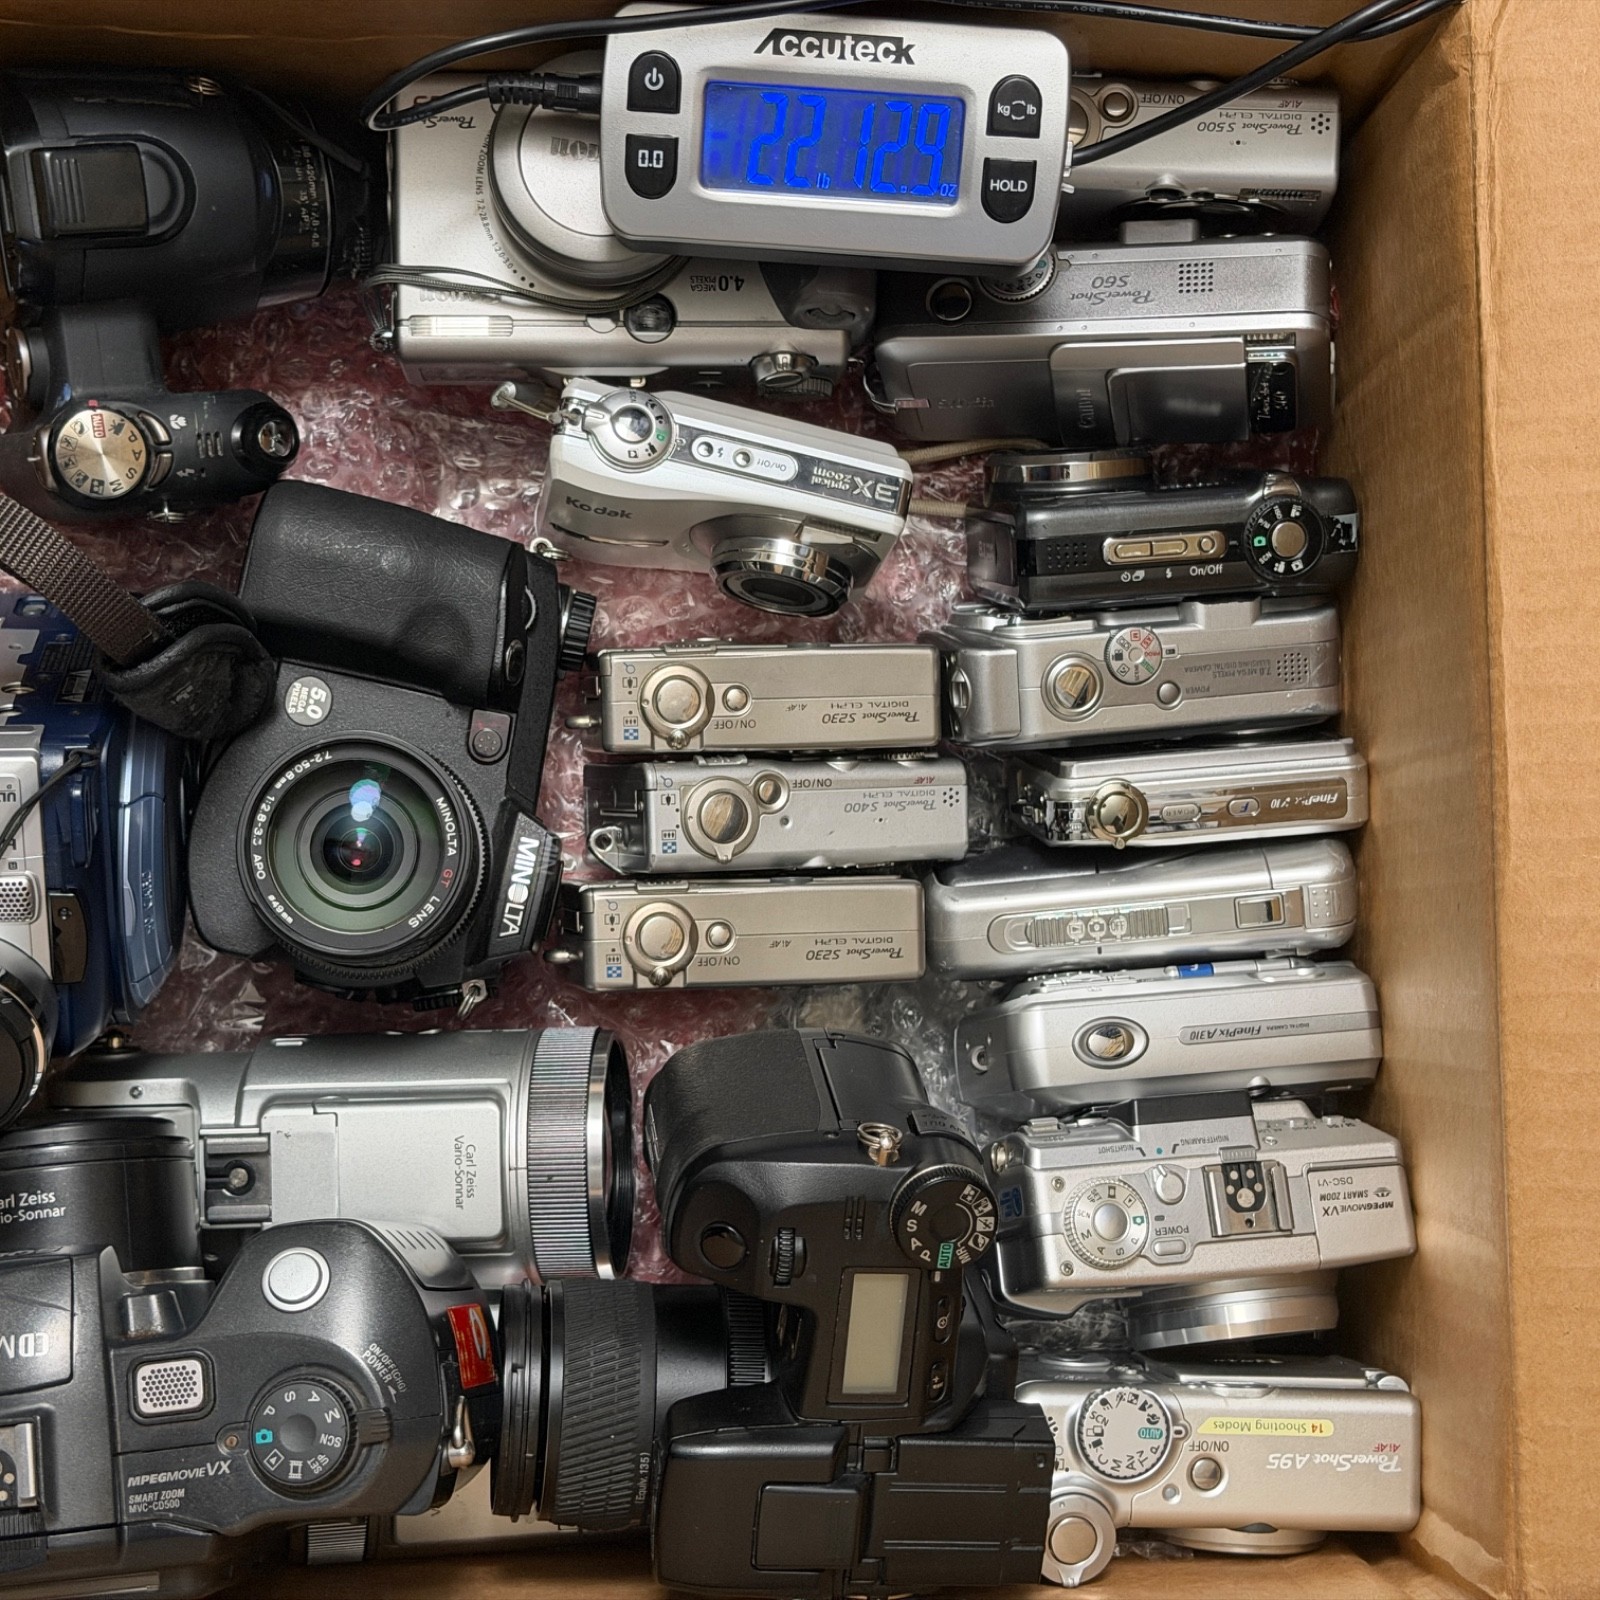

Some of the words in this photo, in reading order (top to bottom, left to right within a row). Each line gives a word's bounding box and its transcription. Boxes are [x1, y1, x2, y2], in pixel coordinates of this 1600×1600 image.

[754, 27, 917, 65] Accuteck
[1140, 92, 1186, 106] ON/OFF
[997, 101, 1011, 118] kg
[1026, 103, 1037, 115] lb
[1258, 112, 1303, 121] DIGITAL
[1197, 120, 1237, 133] S500
[1242, 121, 1303, 136] PowerShot
[745, 92, 828, 189] 22
[816, 172, 832, 190] lb
[852, 101, 952, 197] 12.9
[476, 148, 488, 173] ZOOM
[475, 173, 485, 196] LENS
[989, 176, 1029, 193] HOLD
[689, 274, 717, 283] PIXELS
[718, 275, 745, 292] 4.0
[1091, 274, 1131, 289] S60
[690, 282, 716, 292] MEGA
[1070, 290, 1156, 306] PowerShot
[92, 412, 106, 439] AUTO
[124, 432, 136, 444] P
[131, 448, 142, 461] A
[756, 457, 788, 473] On/Off
[125, 466, 137, 480] S
[812, 464, 852, 482] zoom
[108, 478, 124, 494] M
[811, 474, 851, 493] optical
[853, 476, 900, 505] 3X
[565, 495, 635, 521] Kodak
[1258, 550, 1273, 565] SCN
[1189, 563, 1224, 577] On/Off
[287, 682, 302, 714] PIXELS
[1185, 686, 1211, 695] POWER
[295, 686, 309, 714] MEGA
[308, 686, 328, 720] 5.0
[871, 700, 910, 708] DIGITAL
[713, 718, 757, 730] ON/OFF
[821, 711, 857, 725] S230
[861, 709, 920, 725] PowerShot
[273, 750, 334, 791] 7.2-50.8mm
[791, 777, 833, 788] ON/OFF
[900, 788, 936, 797] DIGITAL
[843, 801, 878, 814] S400
[882, 798, 938, 812] PowerShot
[1165, 808, 1196, 817] POWER
[435, 796, 457, 858] MINOLTA
[252, 853, 267, 880] APO
[442, 867, 455, 889] GT
[499, 836, 540, 939] MINOLTA
[408, 895, 441, 929] LENS
[856, 935, 894, 944] DIGITAL
[805, 948, 841, 961] S230
[844, 945, 905, 960] PowerShot
[697, 955, 741, 967] ON/OFF
[1218, 1025, 1262, 1038] FinePix
[1289, 1022, 1310, 1030] DIGITAL
[1189, 1027, 1219, 1041] A310
[1180, 1134, 1230, 1147] NIGHTFRAMING
[465, 1143, 477, 1170] Carl
[1097, 1143, 1135, 1155] NIGHTSHOT
[452, 1134, 467, 1212] Vario-Sonnar
[463, 1171, 477, 1200] Zeiss
[1316, 1176, 1354, 1188] DSC-V1
[18, 1189, 57, 1208] Zeiss
[1086, 1193, 1097, 1204] UP
[1090, 1187, 1103, 1202] SET
[1318, 1191, 1342, 1202] ZOOM
[1342, 1188, 1370, 1200] SMART
[910, 1200, 928, 1217] M
[1076, 1208, 1091, 1219] SCN
[906, 1218, 919, 1233] S
[1154, 1224, 1190, 1237] POWER
[1080, 1228, 1093, 1242] M
[1130, 1236, 1140, 1247] P
[910, 1237, 923, 1252] A
[1096, 1245, 1106, 1257] A
[1115, 1246, 1126, 1257] S
[919, 1249, 932, 1263] P
[939, 1244, 952, 1269] AUTO
[362, 1348, 394, 1385] POWER
[367, 1342, 409, 1394] ON/OFF(CHG)
[284, 1390, 297, 1404] S
[307, 1389, 321, 1403] A
[262, 1404, 276, 1417] P
[323, 1407, 341, 1424] M
[1089, 1410, 1110, 1427] SCN
[1213, 1418, 1253, 1432] Modes
[1139, 1428, 1161, 1439] AUTO
[1254, 1420, 1309, 1436] Shooting
[1310, 1421, 1325, 1434] 14
[319, 1432, 343, 1449] SCN
[1188, 1440, 1230, 1453] ON/OFF
[1149, 1444, 1161, 1455] P
[306, 1456, 323, 1475] SET
[316, 1452, 330, 1467] UP
[1097, 1453, 1109, 1466] C
[1110, 1458, 1123, 1473] M
[1266, 1452, 1307, 1470] A95
[1311, 1453, 1402, 1474] PowerShot
[128, 1490, 159, 1504] SMART
[160, 1486, 186, 1501] ZOOM
[128, 1498, 182, 1514] MVC-CD500
